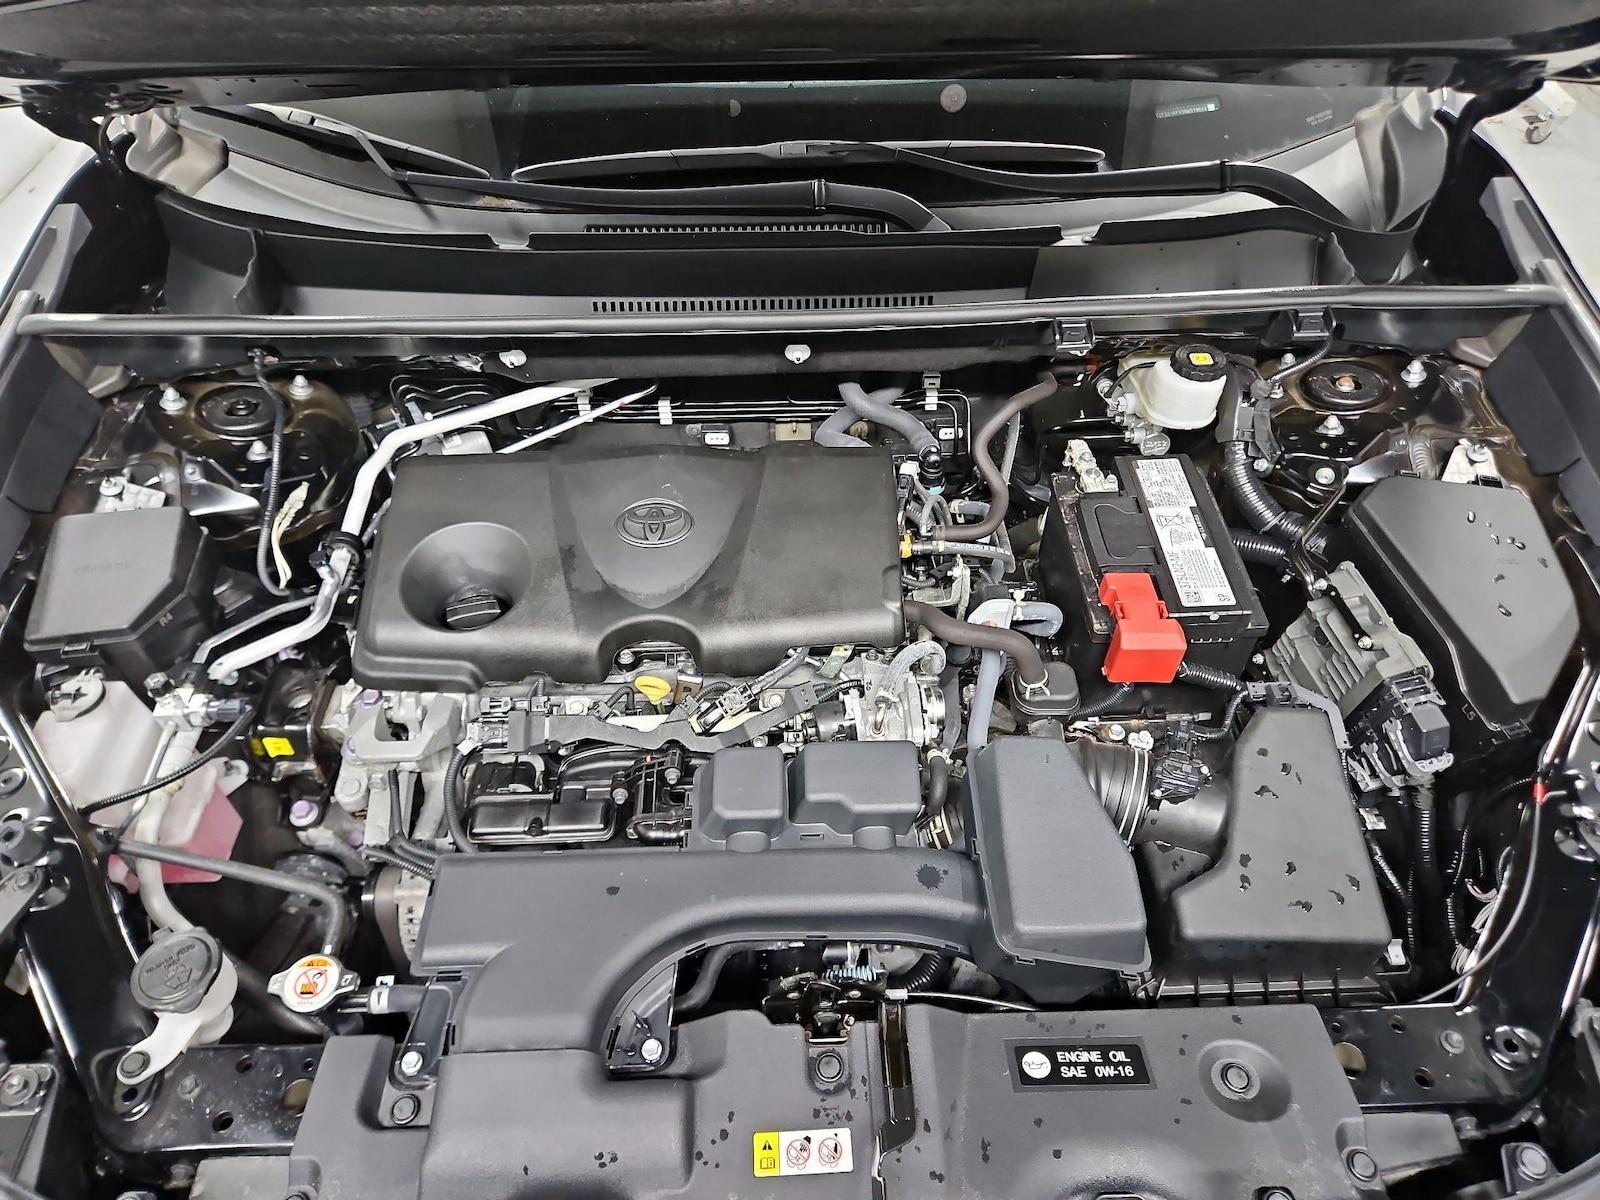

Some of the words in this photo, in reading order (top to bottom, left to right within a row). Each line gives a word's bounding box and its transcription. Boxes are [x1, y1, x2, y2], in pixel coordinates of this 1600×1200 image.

[1217, 593, 1231, 602] SP
[159, 612, 173, 627] R4
[1461, 703, 1476, 721] L5
[1056, 1051, 1103, 1063] ENGINE
[1109, 1050, 1131, 1062] OIL
[1061, 1066, 1087, 1078] SAE
[1094, 1065, 1135, 1078] 0W-16
